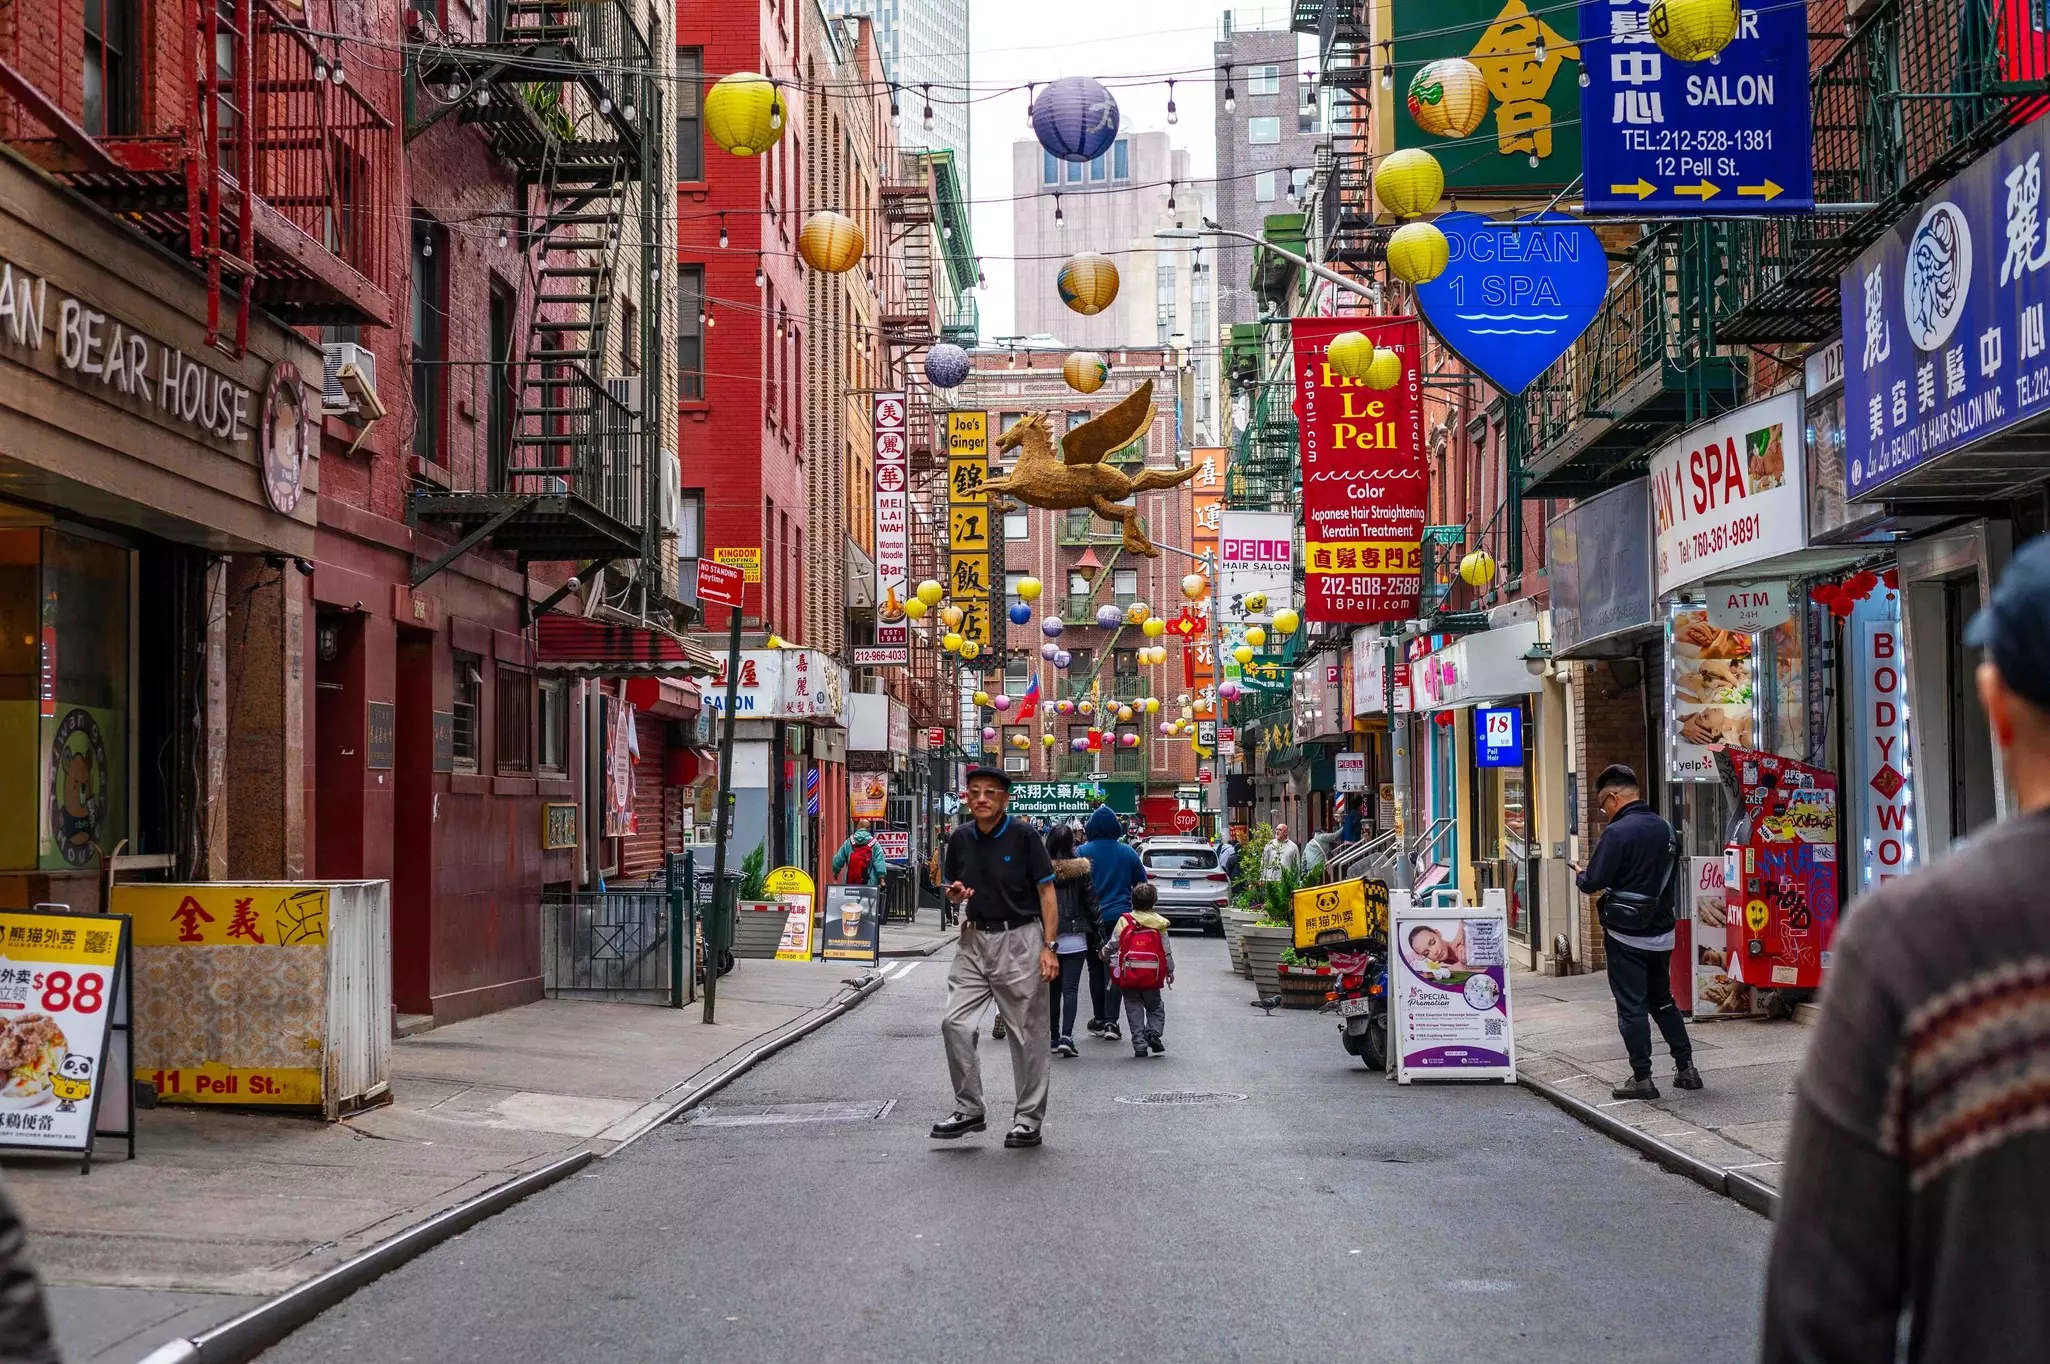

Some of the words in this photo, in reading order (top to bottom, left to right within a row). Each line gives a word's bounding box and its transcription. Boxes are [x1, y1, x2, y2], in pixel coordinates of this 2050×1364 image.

[1610, 0, 1664, 124] 髮中心
[1687, 75, 1773, 105] SALON
[1622, 130, 1772, 150] TEL:212-528-1381
[1656, 157, 1675, 175] 12
[1681, 158, 1712, 175] Pell
[1717, 158, 1739, 176] St.
[1445, 231, 1578, 262] OCEAN
[1449, 276, 1464, 306] 1
[1481, 276, 1560, 306] SPA
[59, 299, 151, 401] BEAR
[162, 348, 249, 441] HOUSE
[1340, 393, 1384, 417] Le
[955, 417, 979, 431] Joe's
[1892, 427, 1920, 466] BEAUTY
[1922, 424, 1927, 451] &
[1929, 413, 1949, 449] HAIR
[1950, 397, 1981, 437] SALON
[1985, 386, 2004, 422] INC.
[950, 435, 984, 449] Ginger
[1332, 422, 1397, 448] Pell
[879, 402, 902, 490] 美麗華
[1676, 460, 1686, 521] 1
[1690, 437, 1746, 514] SPA
[1347, 483, 1385, 498] Color
[880, 499, 902, 507] MEI
[881, 512, 902, 520] LAI
[1312, 508, 1349, 524] Japanese
[1351, 505, 1369, 519] Hair
[1371, 504, 1424, 523] Straightening
[880, 524, 903, 532] WAH
[1322, 524, 1359, 538] Keratin
[1361, 524, 1413, 537] Treatment
[1679, 539, 1691, 565] Tel:
[1693, 513, 1759, 559] 760-361-9891
[719, 549, 757, 557] KINGDOM
[1226, 541, 1288, 560] PELL
[700, 572, 724, 584] Anytime
[710, 565, 737, 578] STANDING
[881, 564, 903, 575] Bar
[1321, 577, 1420, 595] 212-608-2588
[1327, 598, 1409, 609] 18Pell.com
[1728, 592, 1769, 609] ATM
[1740, 610, 1758, 619] 24H
[856, 649, 907, 663] 212-966-4033
[1874, 633, 1898, 761] BODY
[1489, 716, 1508, 733] 18
[1679, 761, 1701, 771] yelp
[684, 789, 692, 798] 15
[1013, 802, 1056, 812] Paradigm
[1059, 802, 1089, 811] Health
[1177, 816, 1196, 825] STOP
[877, 833, 906, 841] ATM
[1877, 805, 1906, 887] WO
[170, 896, 265, 944] 金義
[1306, 910, 1353, 928] 熊猫外卖
[1727, 905, 1742, 926] ATM
[9, 926, 76, 945] 熊猫外卖
[0, 968, 31, 984] 外卖
[32, 970, 104, 1014] $88
[153, 1070, 181, 1093] 11
[196, 1074, 238, 1094] Pell
[250, 1074, 281, 1095] St.
